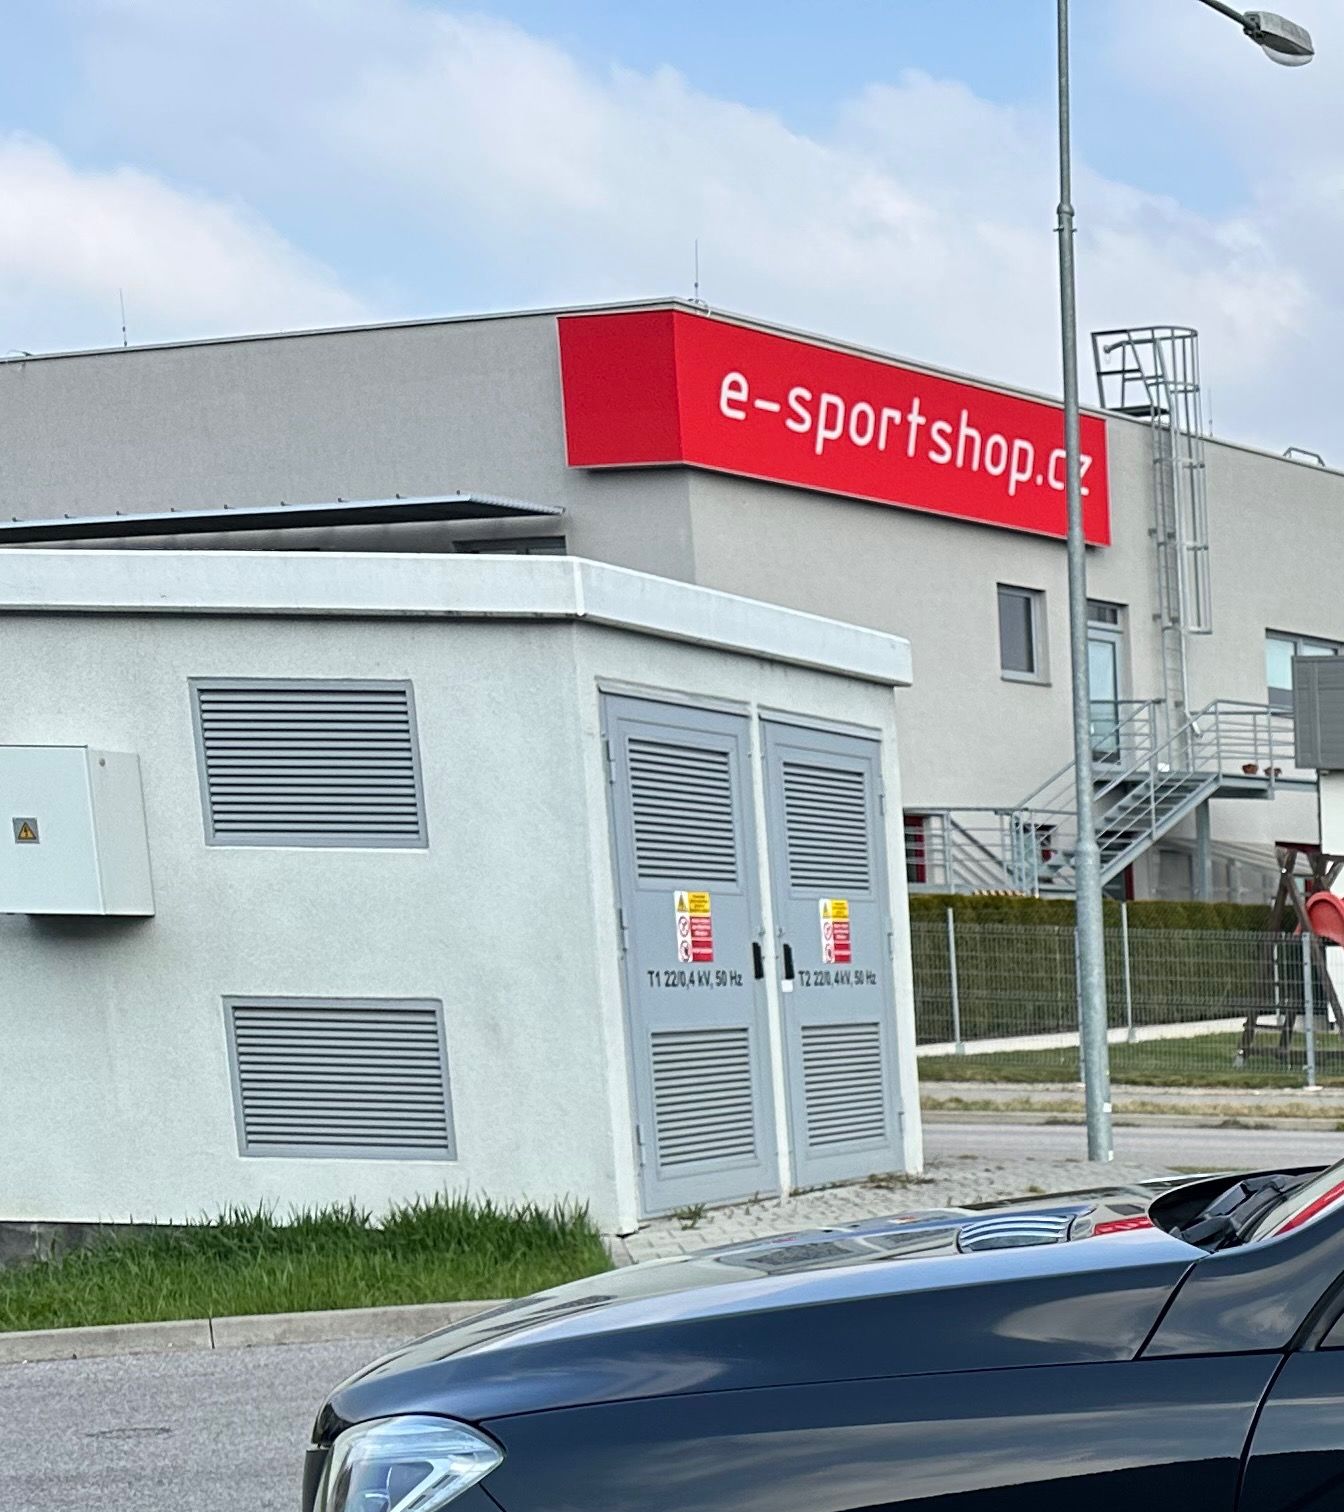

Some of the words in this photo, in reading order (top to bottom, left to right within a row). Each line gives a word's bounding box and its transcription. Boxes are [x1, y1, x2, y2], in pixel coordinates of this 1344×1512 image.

[647, 969, 661, 988] T1
[715, 969, 728, 987] 50
[729, 969, 744, 987] Hz
[798, 969, 812, 988] T2
[854, 969, 865, 986] 50
[866, 969, 878, 986] Hz
